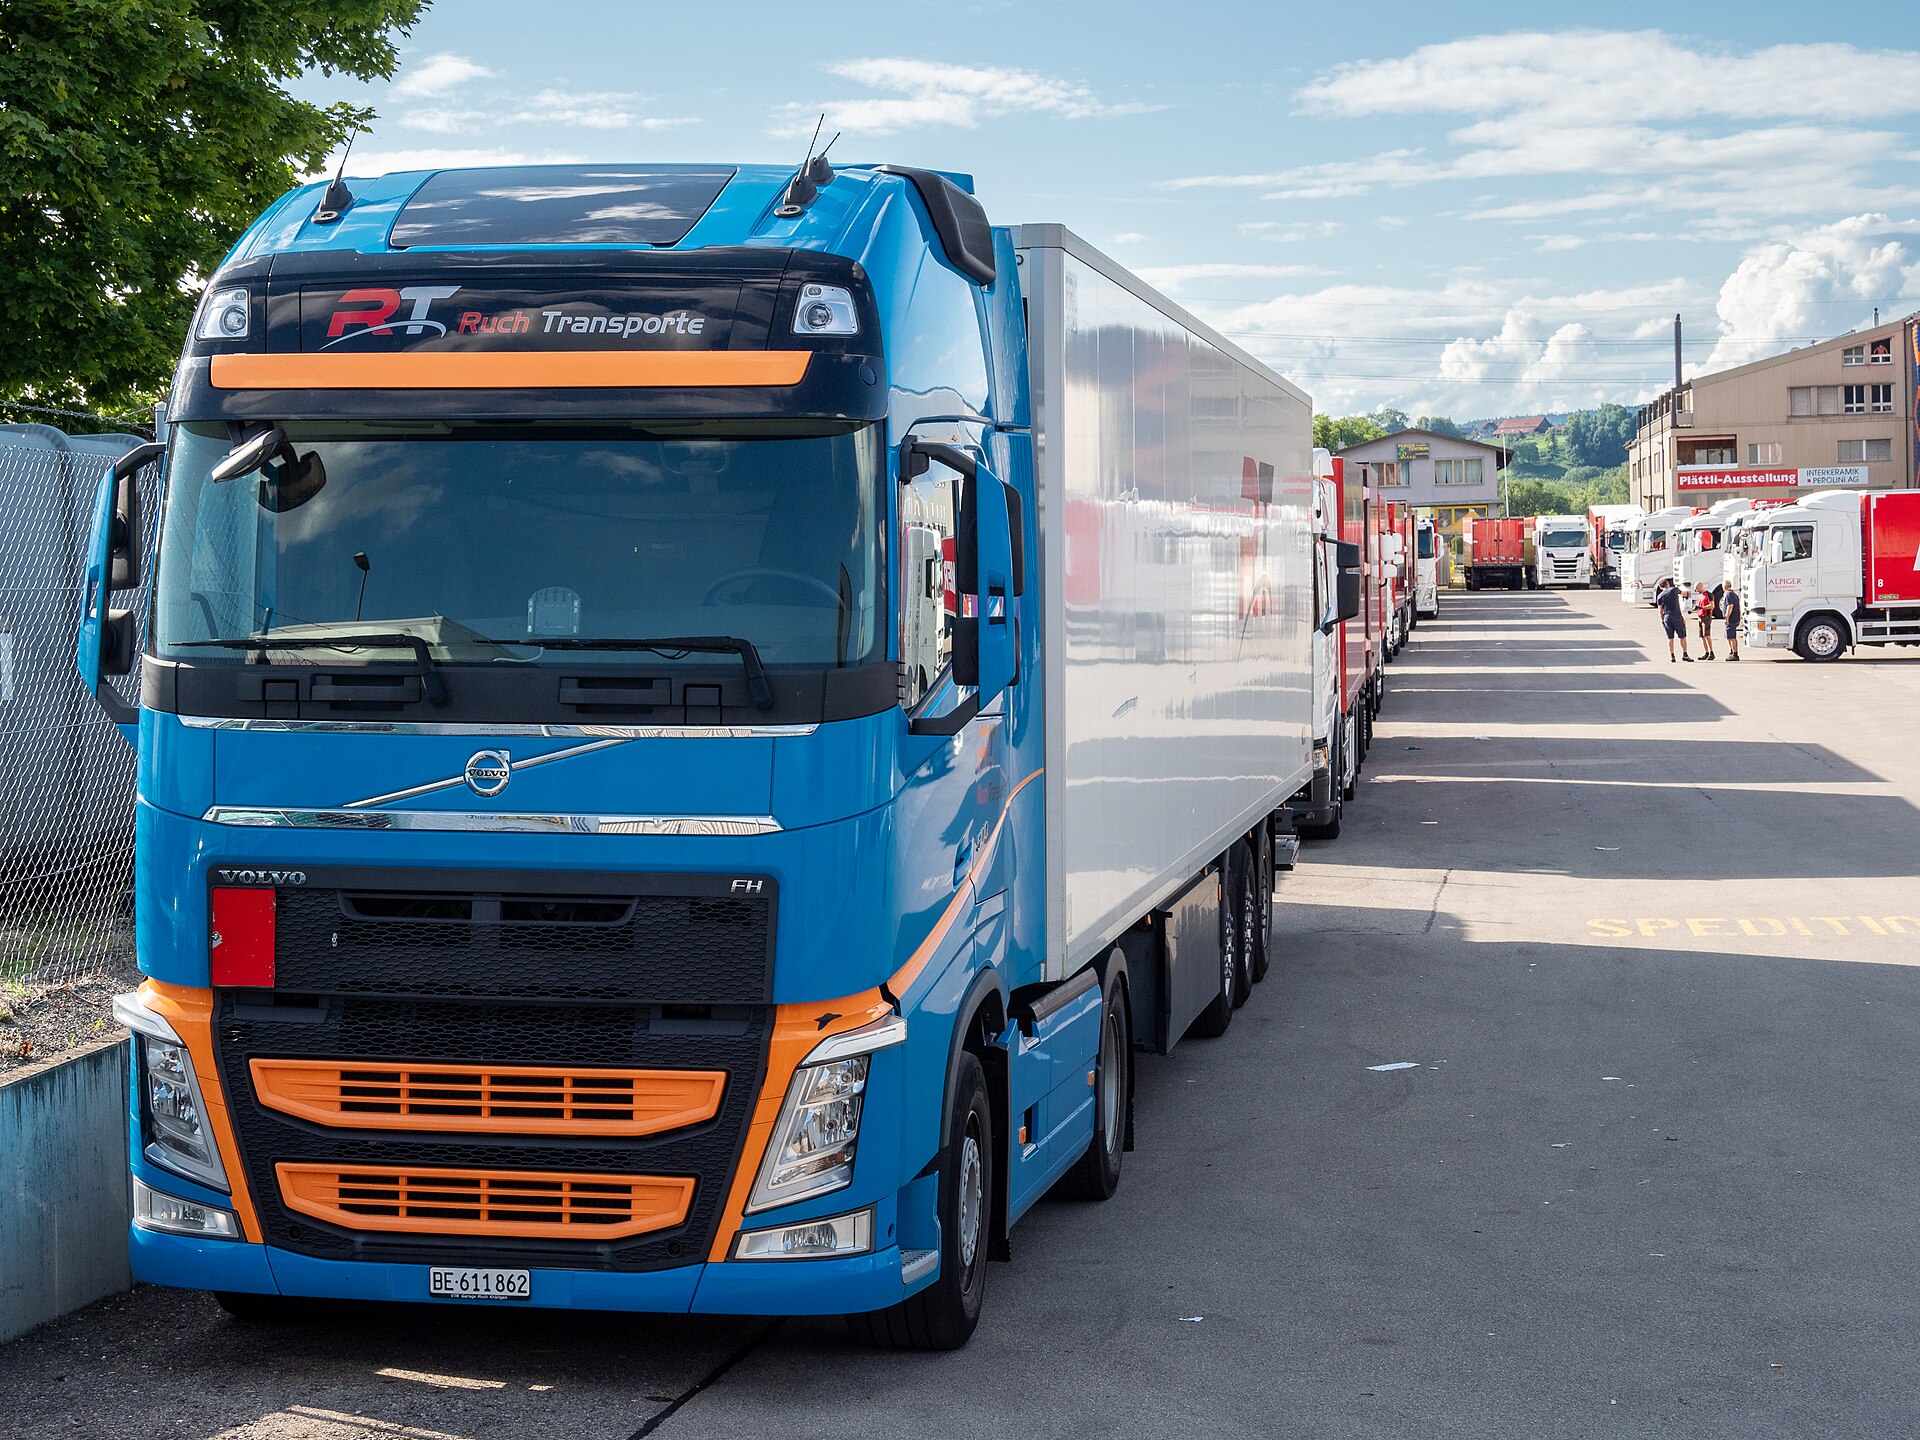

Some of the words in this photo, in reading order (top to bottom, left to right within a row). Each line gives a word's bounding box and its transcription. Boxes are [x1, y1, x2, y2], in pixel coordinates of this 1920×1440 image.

[459, 311, 530, 334] Ruch
[542, 311, 705, 339] Transporte
[1806, 468, 1860, 477] INTERKERAMIK
[1679, 473, 1796, 486] Plättli-Ausstellung
[1812, 476, 1846, 484] PEROLINI
[1847, 475, 1860, 483] AG
[1877, 578, 1884, 588] 8
[468, 769, 508, 777] VOLVO
[219, 869, 307, 885] VOLVO
[730, 879, 763, 893] FH
